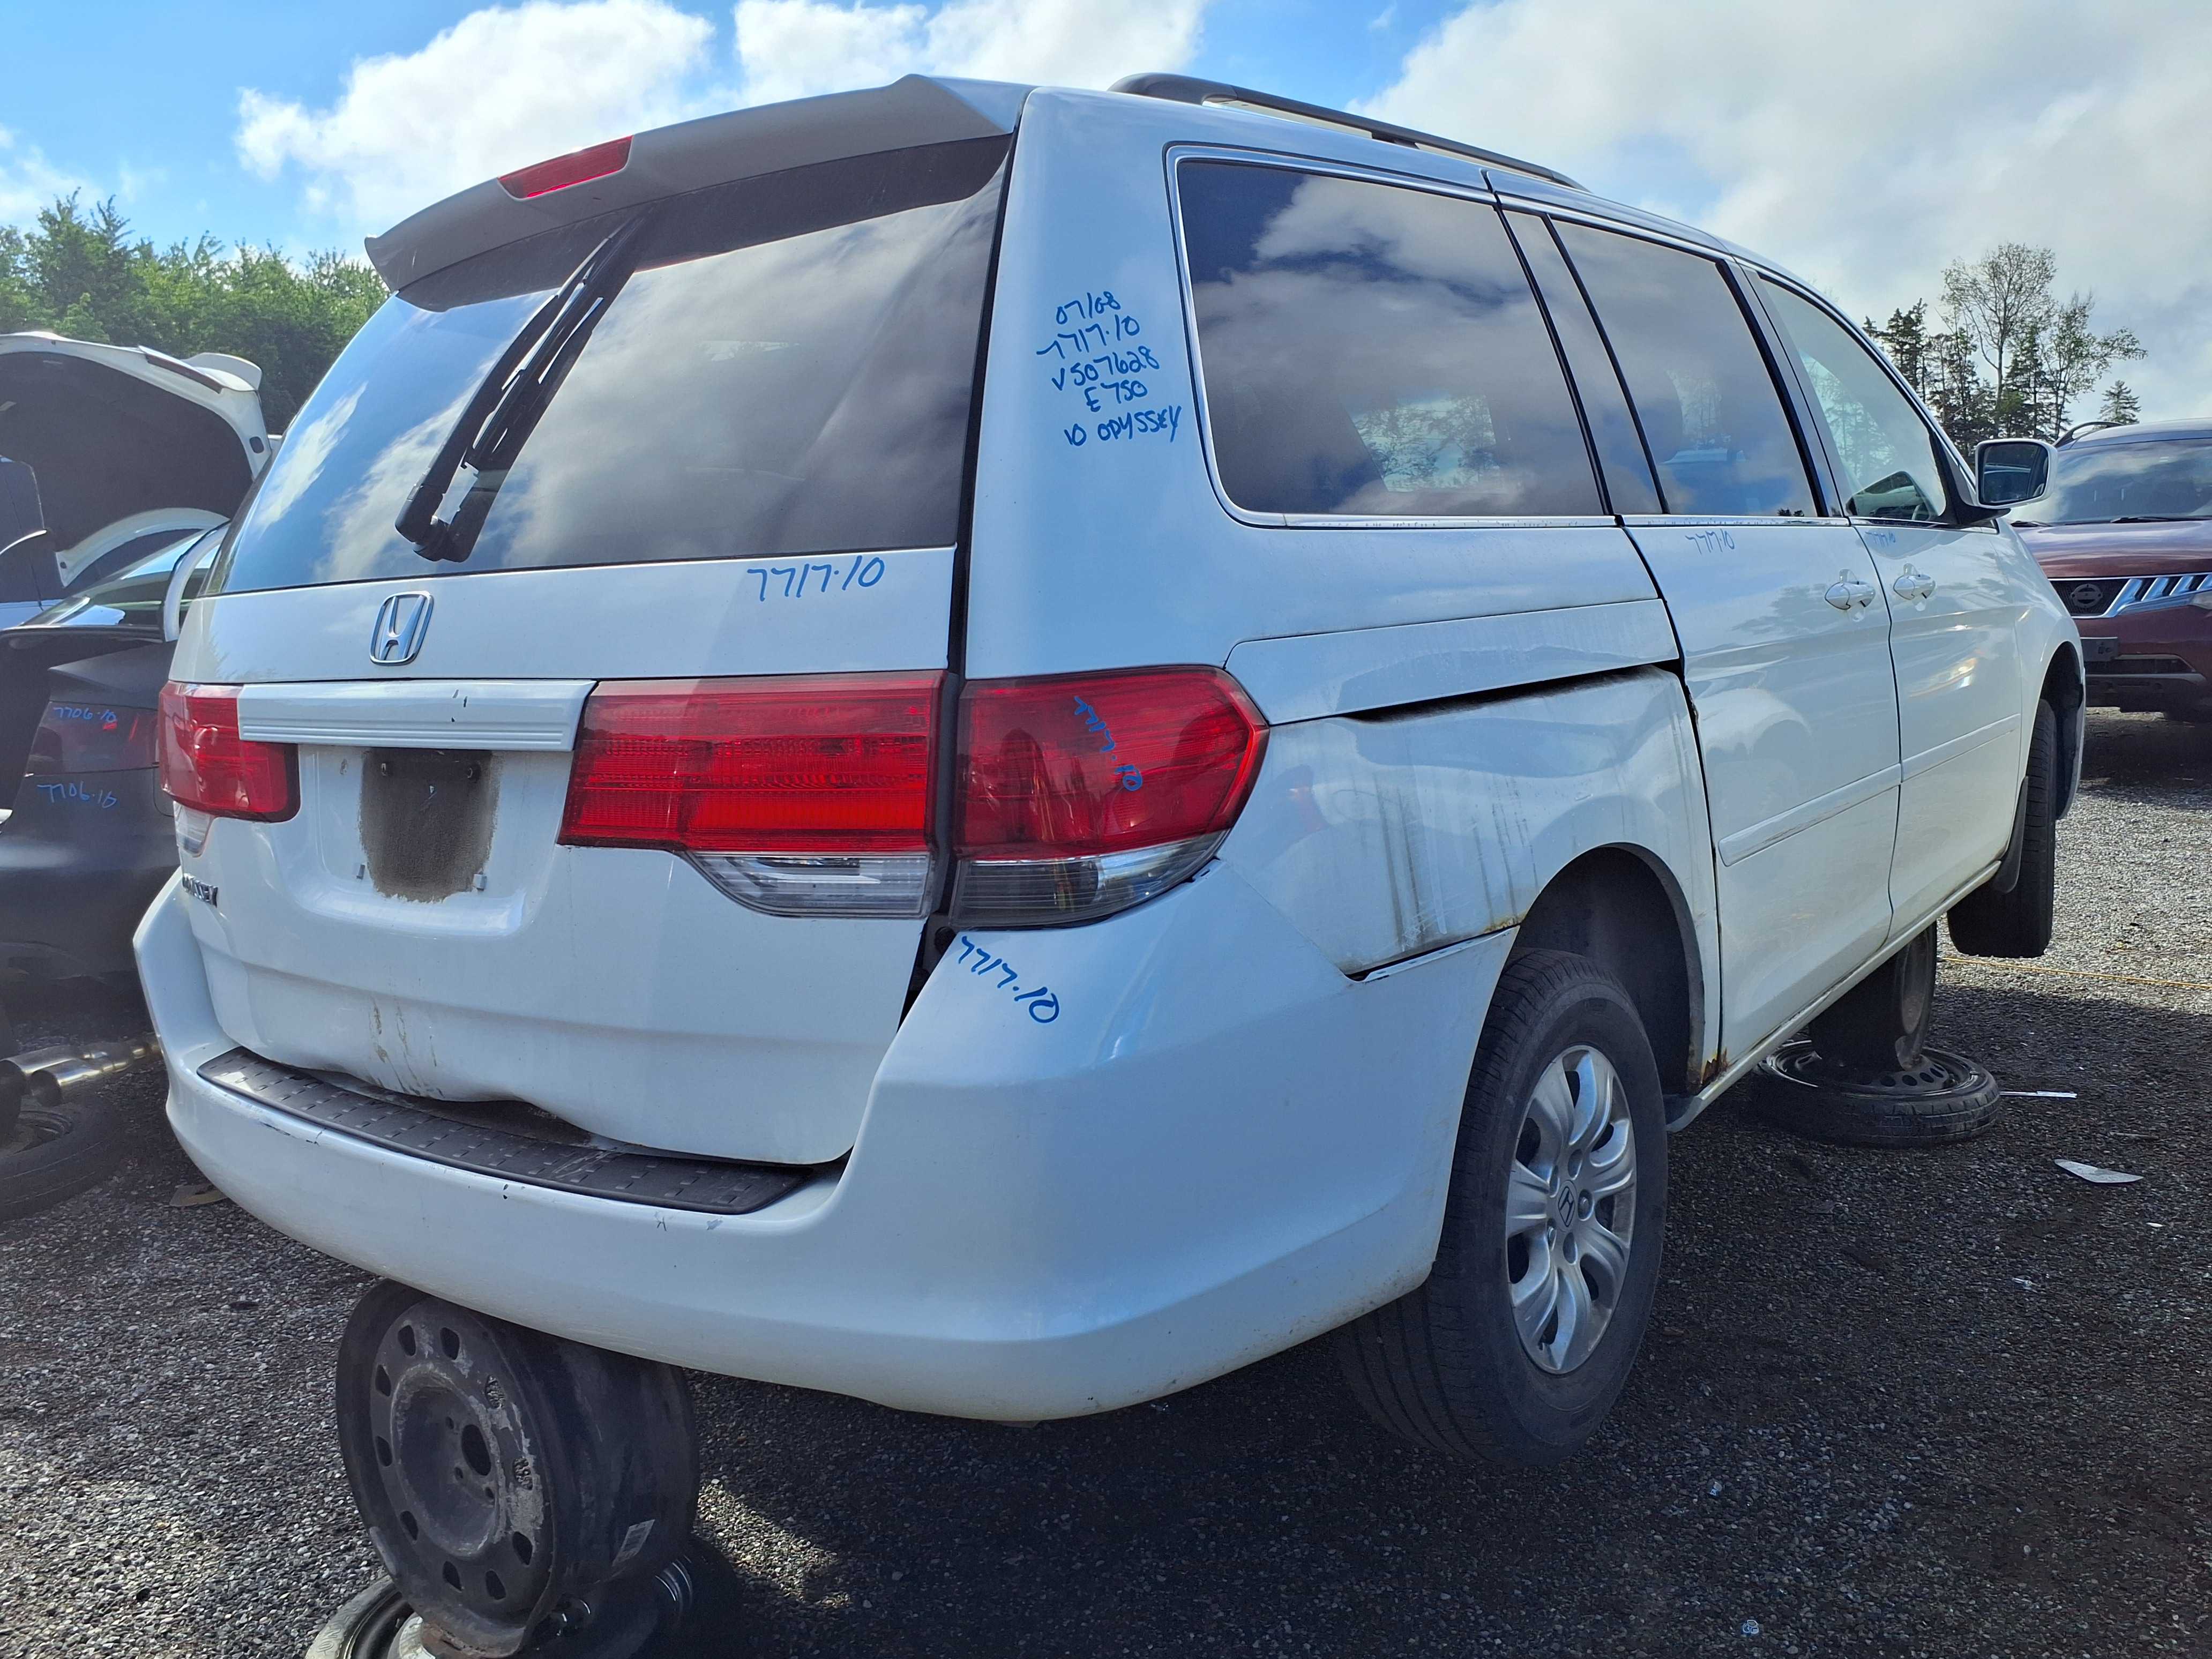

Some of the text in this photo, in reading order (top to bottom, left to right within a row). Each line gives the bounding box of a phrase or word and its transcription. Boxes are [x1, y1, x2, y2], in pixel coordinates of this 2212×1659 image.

[1036, 314, 1140, 360] 7717.10
[1097, 405, 1182, 443] ODYSSEY
[747, 555, 885, 602] 7717.10
[958, 936, 1060, 1023] 7717.10
